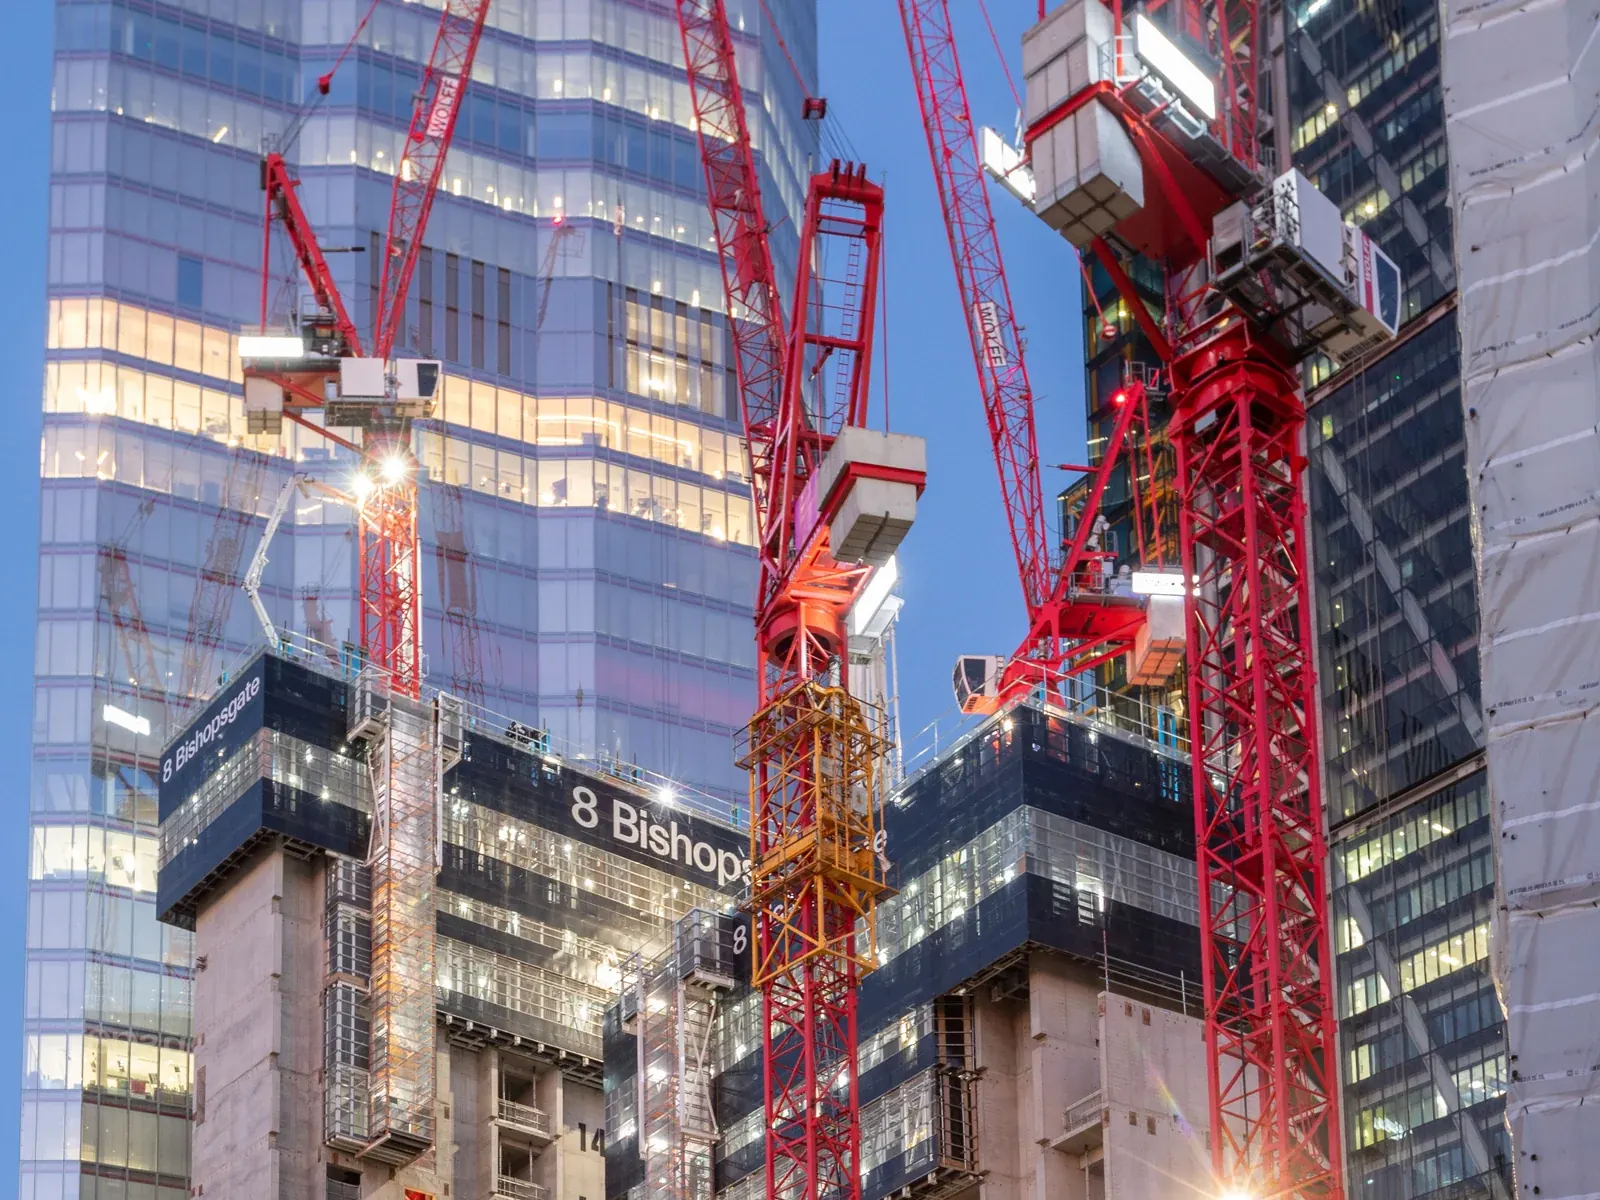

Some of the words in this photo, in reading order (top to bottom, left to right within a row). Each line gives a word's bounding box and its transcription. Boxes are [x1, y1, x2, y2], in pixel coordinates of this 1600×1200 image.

[431, 80, 457, 132] WOLFF
[981, 306, 1003, 365] WOLFF
[162, 758, 173, 783] 8
[176, 676, 260, 772] Bishopsgate
[571, 786, 599, 829] 8
[733, 924, 747, 955] 8
[578, 1122, 606, 1157] 14
